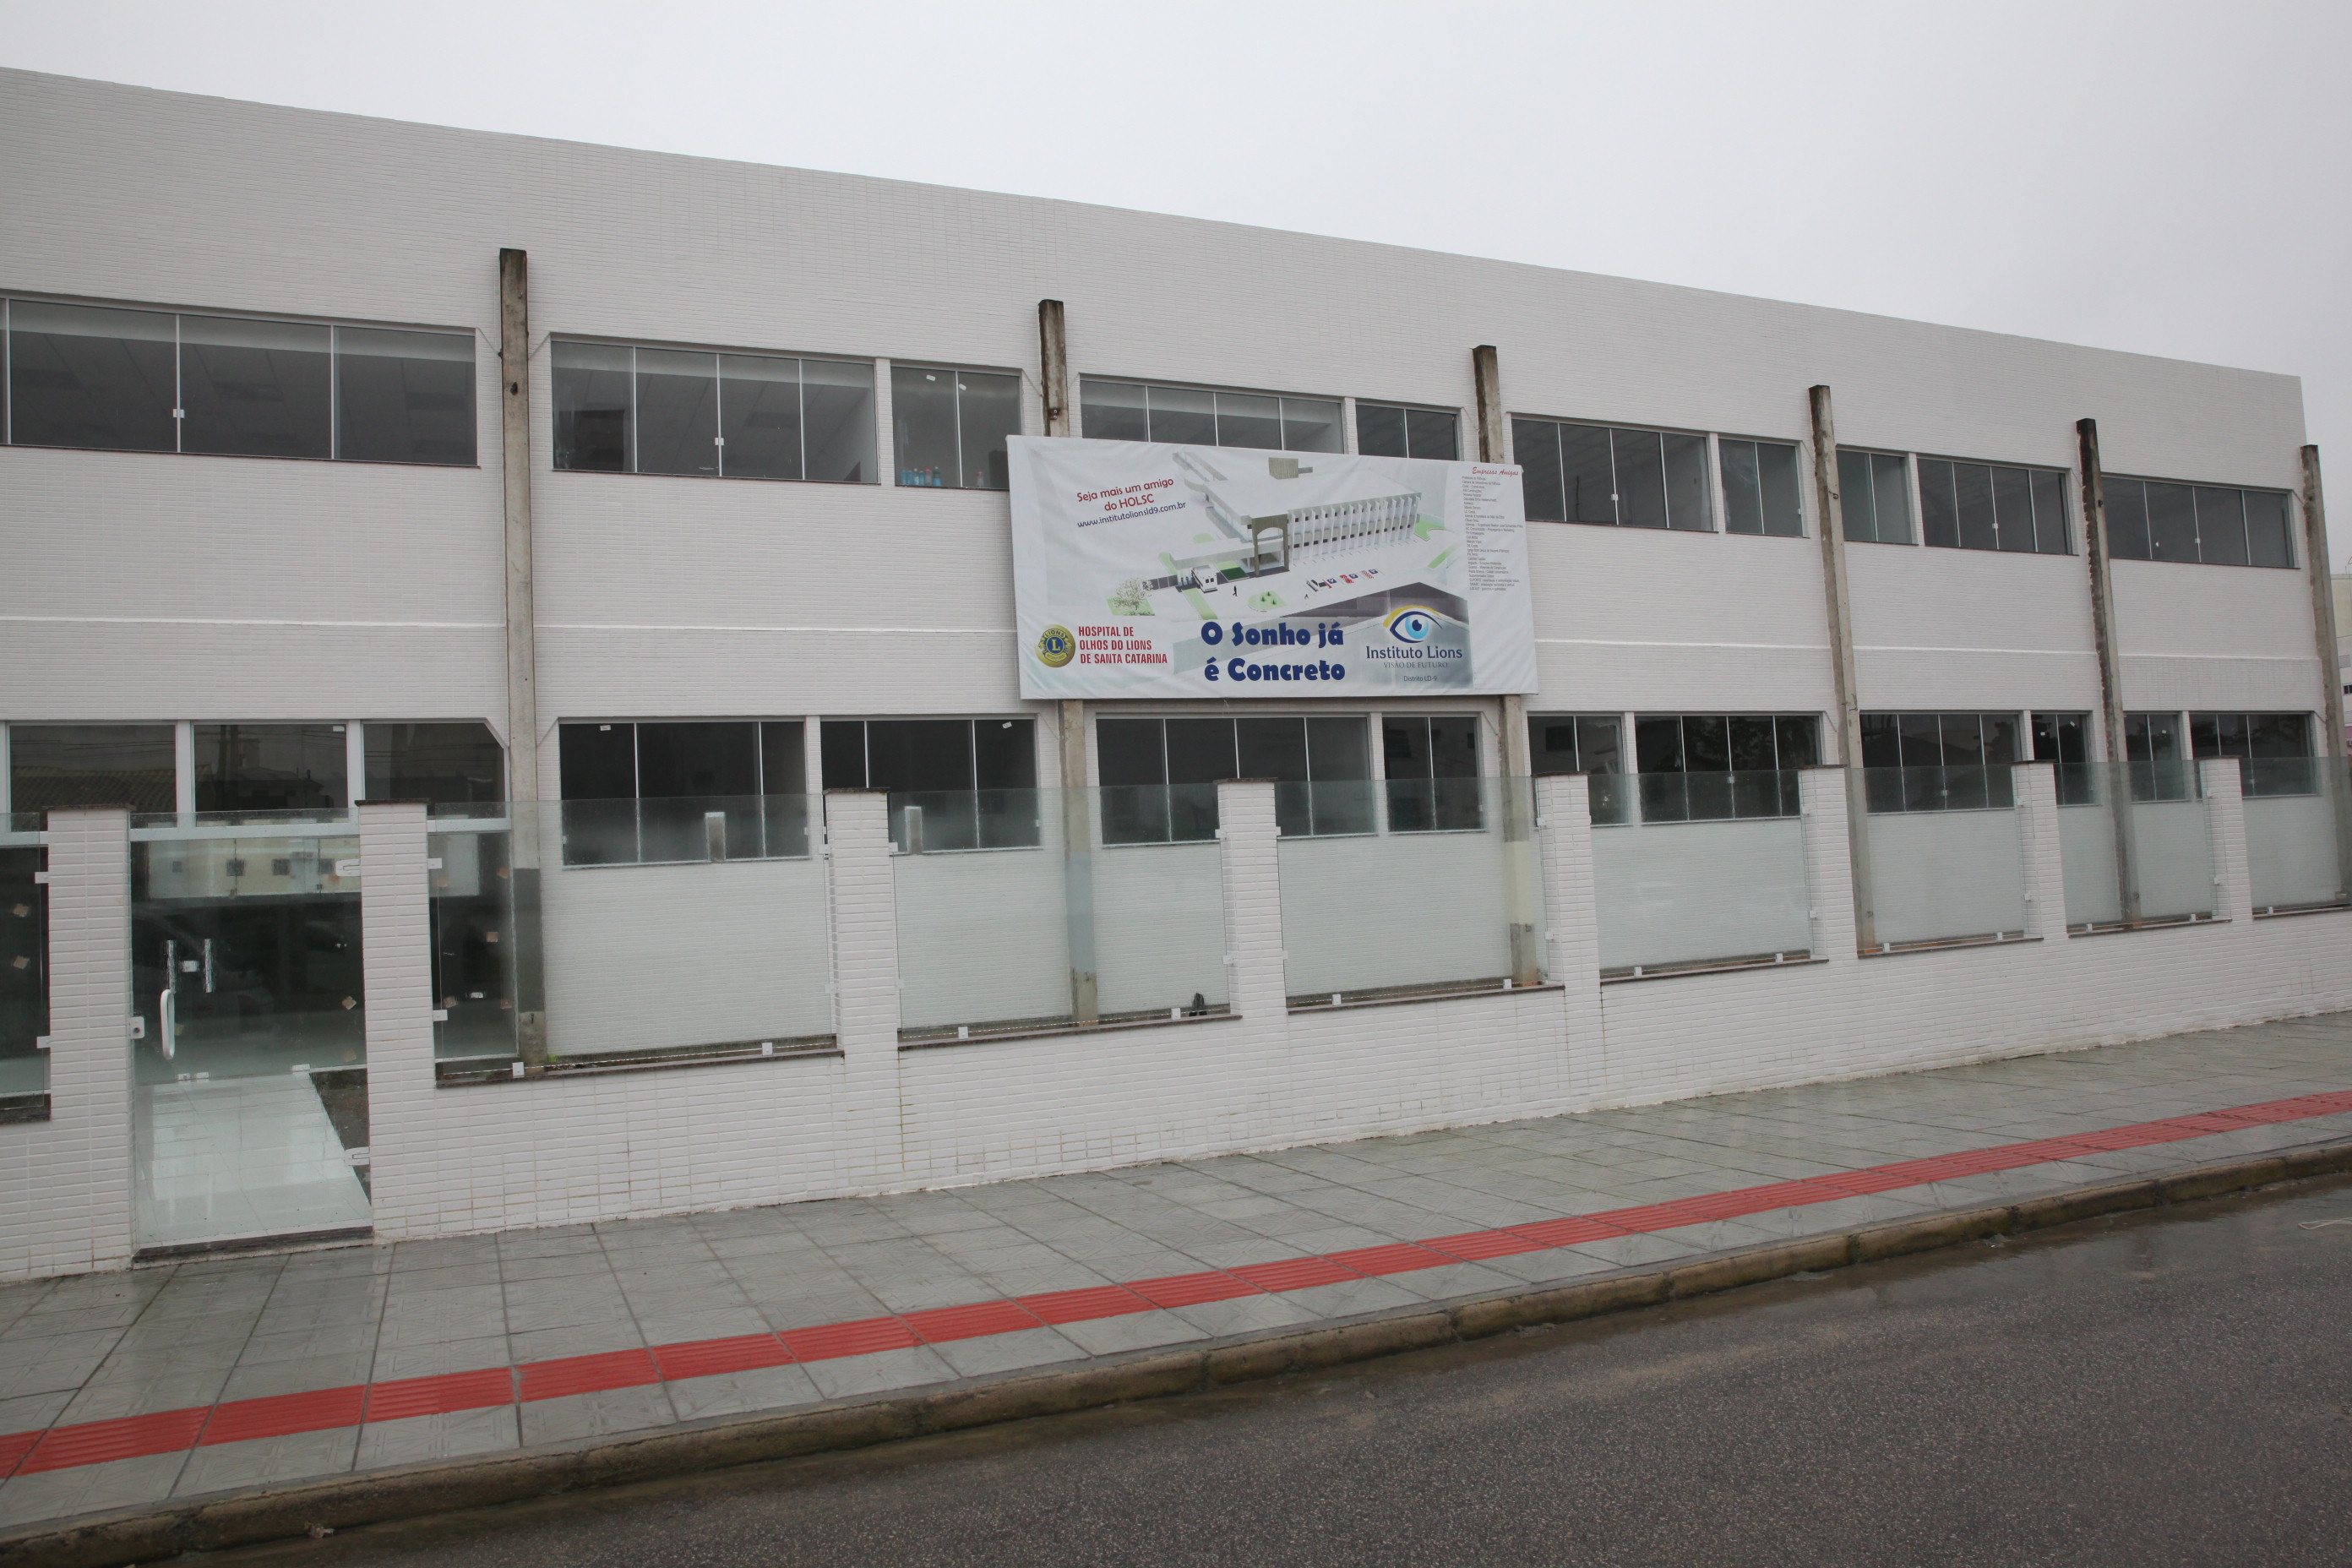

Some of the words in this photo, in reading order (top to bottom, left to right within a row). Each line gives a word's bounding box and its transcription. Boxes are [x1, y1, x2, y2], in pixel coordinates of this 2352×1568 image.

[1473, 466, 1497, 476] Empresas
[1499, 469, 1519, 478] Amigas
[1076, 491, 1098, 503] Seja
[1100, 486, 1123, 498] mais
[1124, 484, 1141, 493] um
[1143, 478, 1174, 491] amigo
[1104, 501, 1117, 511] do
[1119, 493, 1155, 509] HOLSC
[1077, 501, 1186, 528] www.institutolionsld9.com.br
[1044, 629, 1065, 638] LIONS
[1078, 626, 1121, 637] HOSPITAL
[1123, 626, 1135, 637] DE
[1200, 621, 1223, 645] O
[1232, 621, 1311, 646] Sonho
[1318, 621, 1344, 649] já
[1051, 639, 1061, 651] L
[1079, 640, 1108, 651] OLHOS
[1111, 640, 1124, 651] DO
[1126, 640, 1152, 651] LIONS
[1080, 653, 1092, 664] DE
[1094, 653, 1123, 664] SANTA
[1124, 653, 1168, 664] CATARINA
[1365, 645, 1423, 659] Instituto
[1426, 645, 1463, 659] Lions
[1204, 656, 1220, 682] é
[1227, 657, 1346, 682] Concreto
